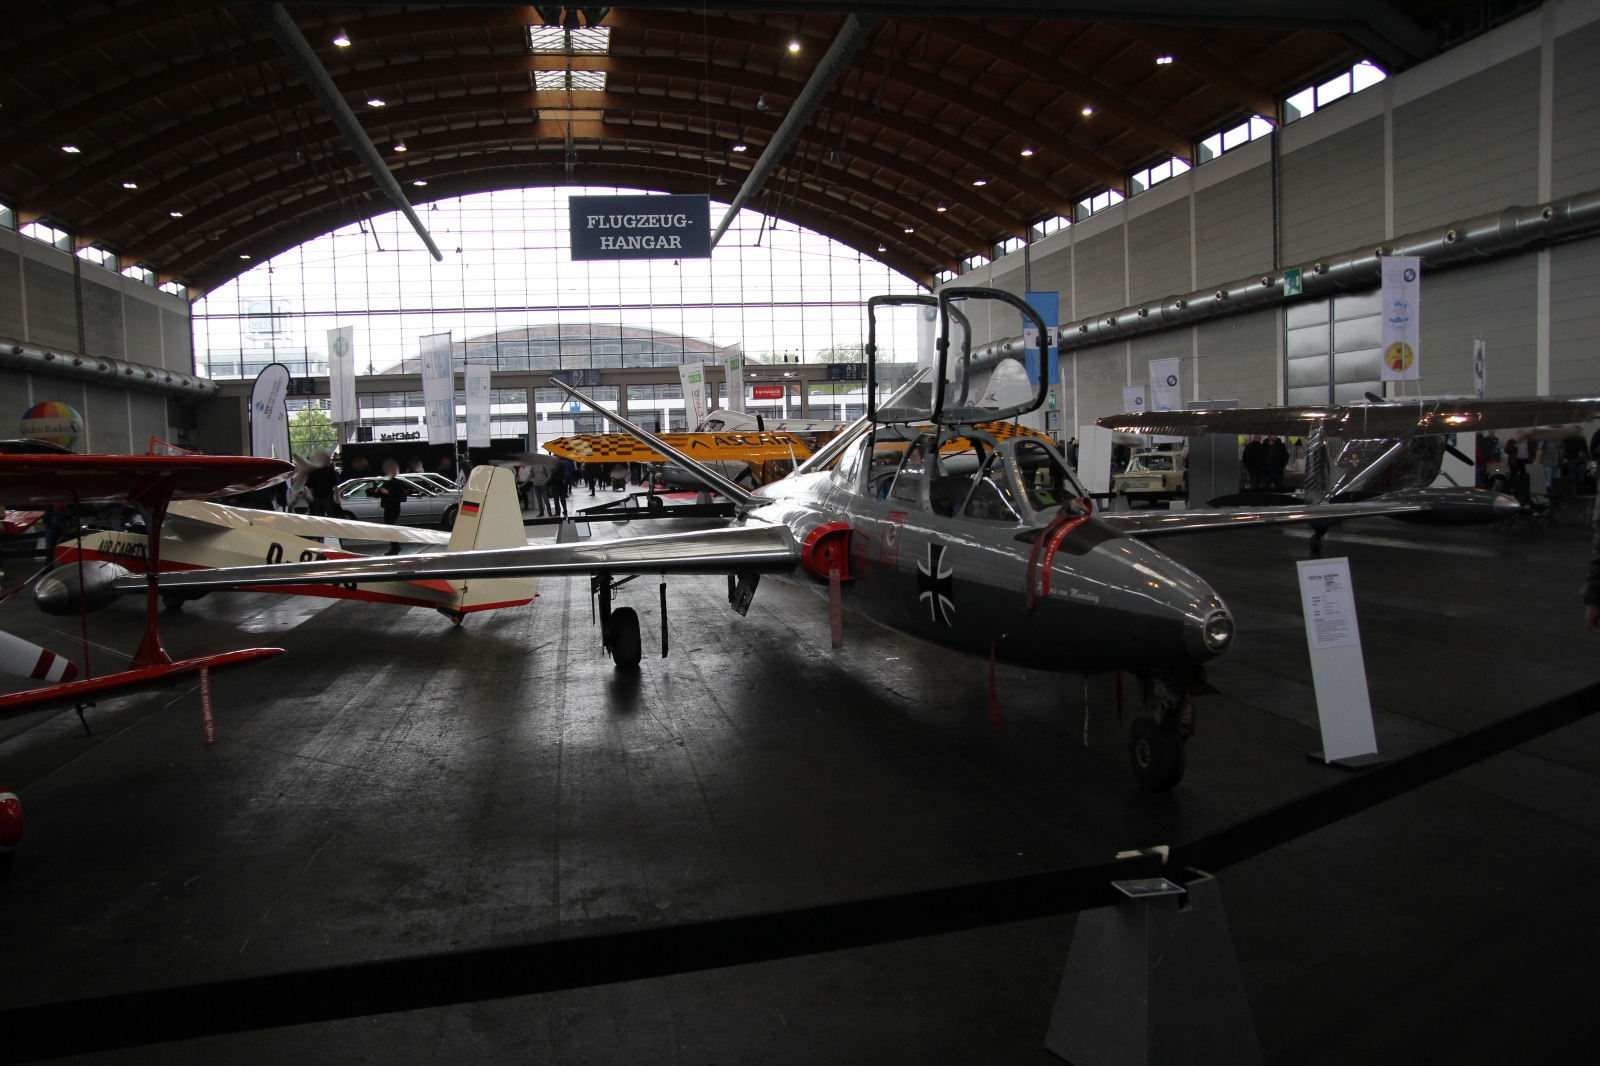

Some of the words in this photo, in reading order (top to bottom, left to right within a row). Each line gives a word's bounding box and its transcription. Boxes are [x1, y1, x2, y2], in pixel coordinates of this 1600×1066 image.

[586, 213, 694, 229] FLUGZEUG-
[600, 235, 682, 250] HANGAR
[251, 320, 277, 330] MESSE
[572, 370, 584, 378] A3
[45, 424, 70, 433] Baden
[202, 695, 212, 721] BEFORE
